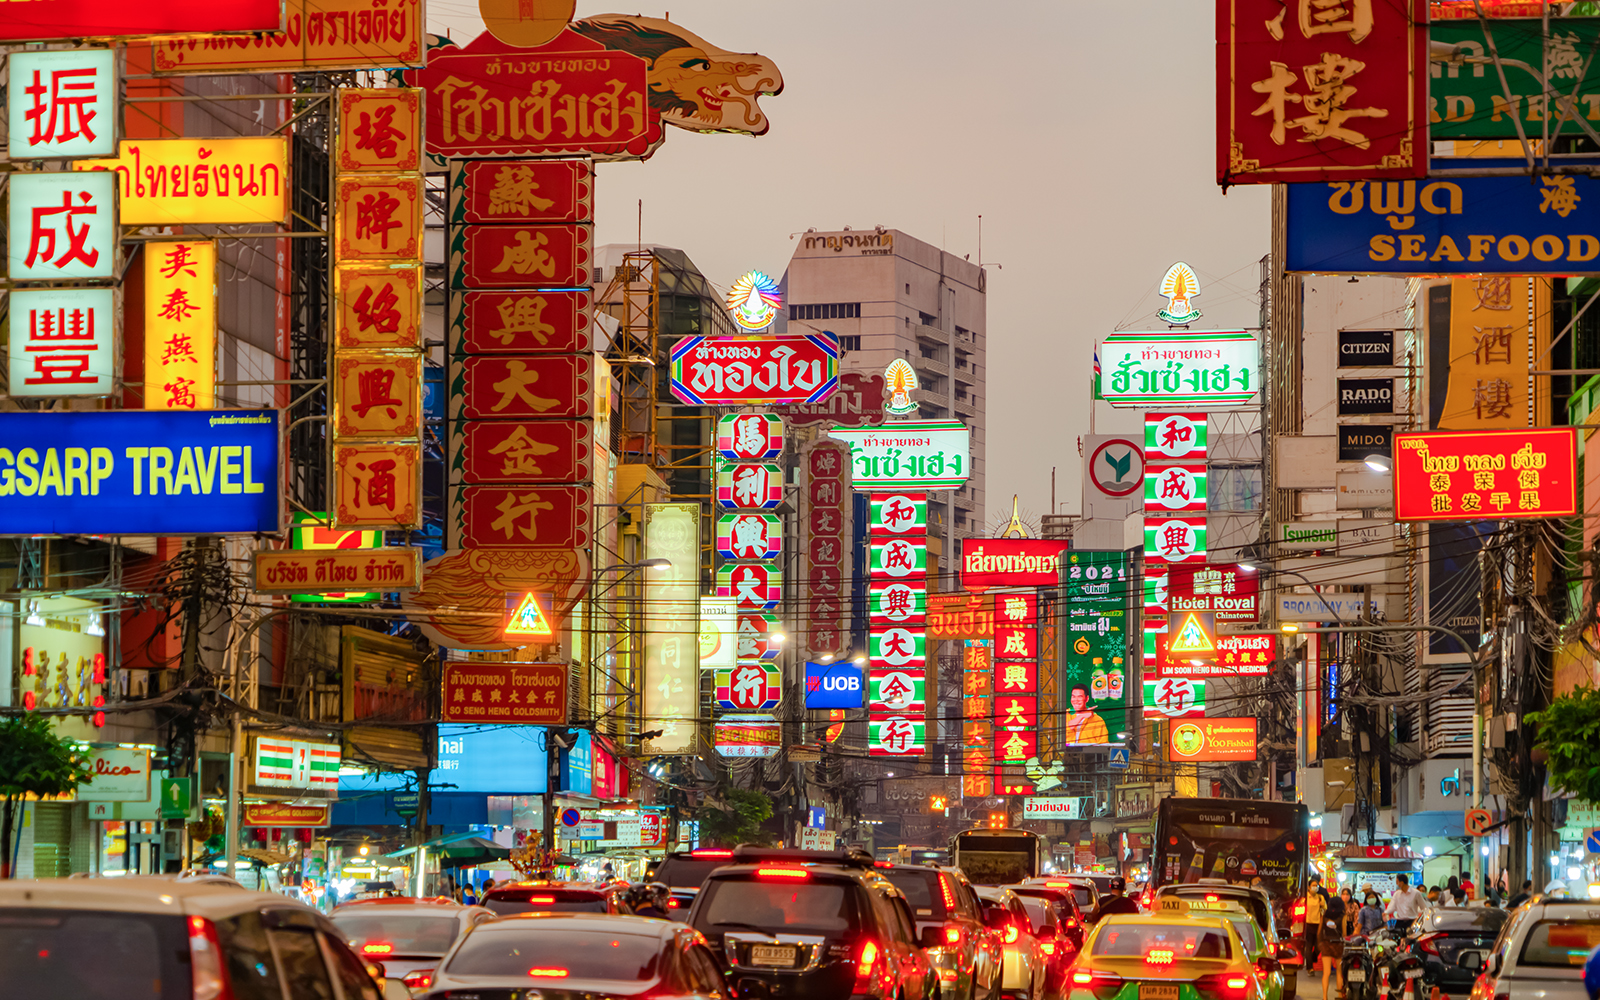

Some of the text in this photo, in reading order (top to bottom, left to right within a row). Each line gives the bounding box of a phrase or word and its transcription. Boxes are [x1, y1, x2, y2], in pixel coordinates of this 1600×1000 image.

[1491, 94, 1600, 122] NEST
[1369, 234, 1600, 262] SEAFOOD
[1141, 346, 1220, 360] ห้างขายทอง
[1341, 343, 1390, 354] CITIZEN
[1342, 388, 1391, 400] RADO
[1347, 435, 1385, 445] MIDO
[1418, 448, 1459, 473] ไทย
[1464, 453, 1505, 472] หลง
[126, 446, 264, 495] TRAVEL
[1352, 529, 1380, 537] BALL
[1157, 420, 1192, 710] 和成興行
[1070, 566, 1126, 581] 2021
[1172, 596, 1255, 610] Hotel Royal
[823, 676, 860, 691] UOB
[450, 706, 560, 716] SO SENG HENG GOLDSMITH
[716, 729, 779, 742] EXCHANGE
[1226, 739, 1254, 747] Fishball
[79, 758, 141, 778] lico
[292, 809, 322, 817] GOLDSMITH
[1230, 811, 1236, 823] 1
[1162, 901, 1180, 910] TAXI
[773, 948, 794, 957] 9555
